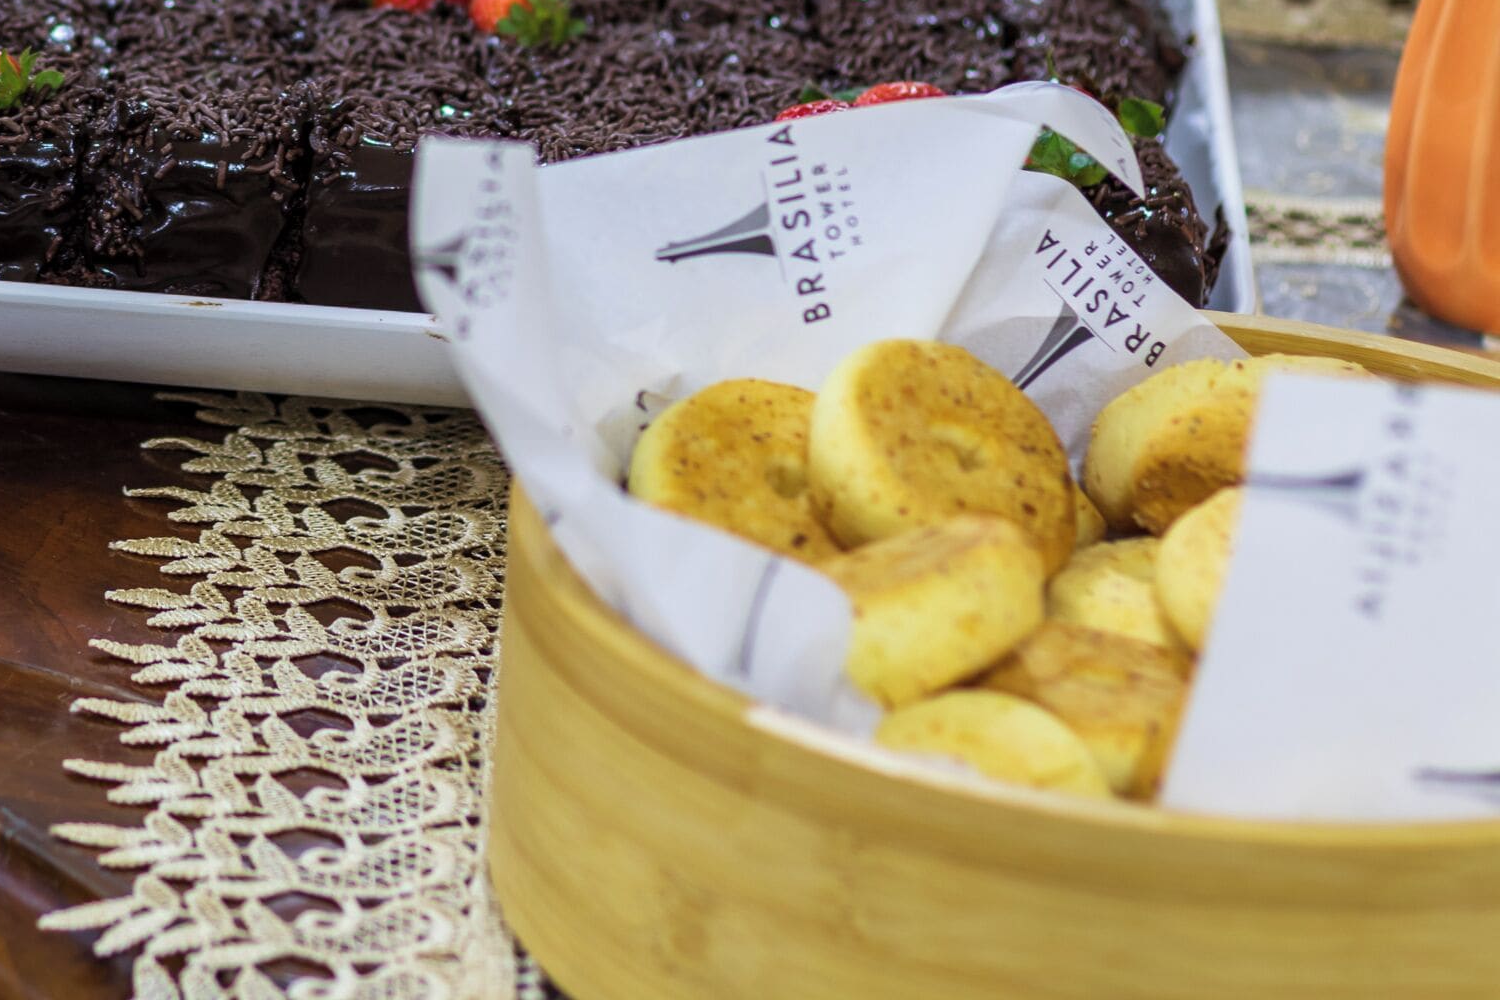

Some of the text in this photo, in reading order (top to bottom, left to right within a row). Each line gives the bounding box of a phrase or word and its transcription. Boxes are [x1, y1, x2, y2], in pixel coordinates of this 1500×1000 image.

[767, 124, 832, 324] BRASILIA
[811, 163, 846, 260] TOWER
[835, 165, 863, 247] HOTEL
[1035, 229, 1167, 368] BRASILIA
[1084, 240, 1146, 308] TOWER
[1106, 234, 1154, 285] HOTEL
